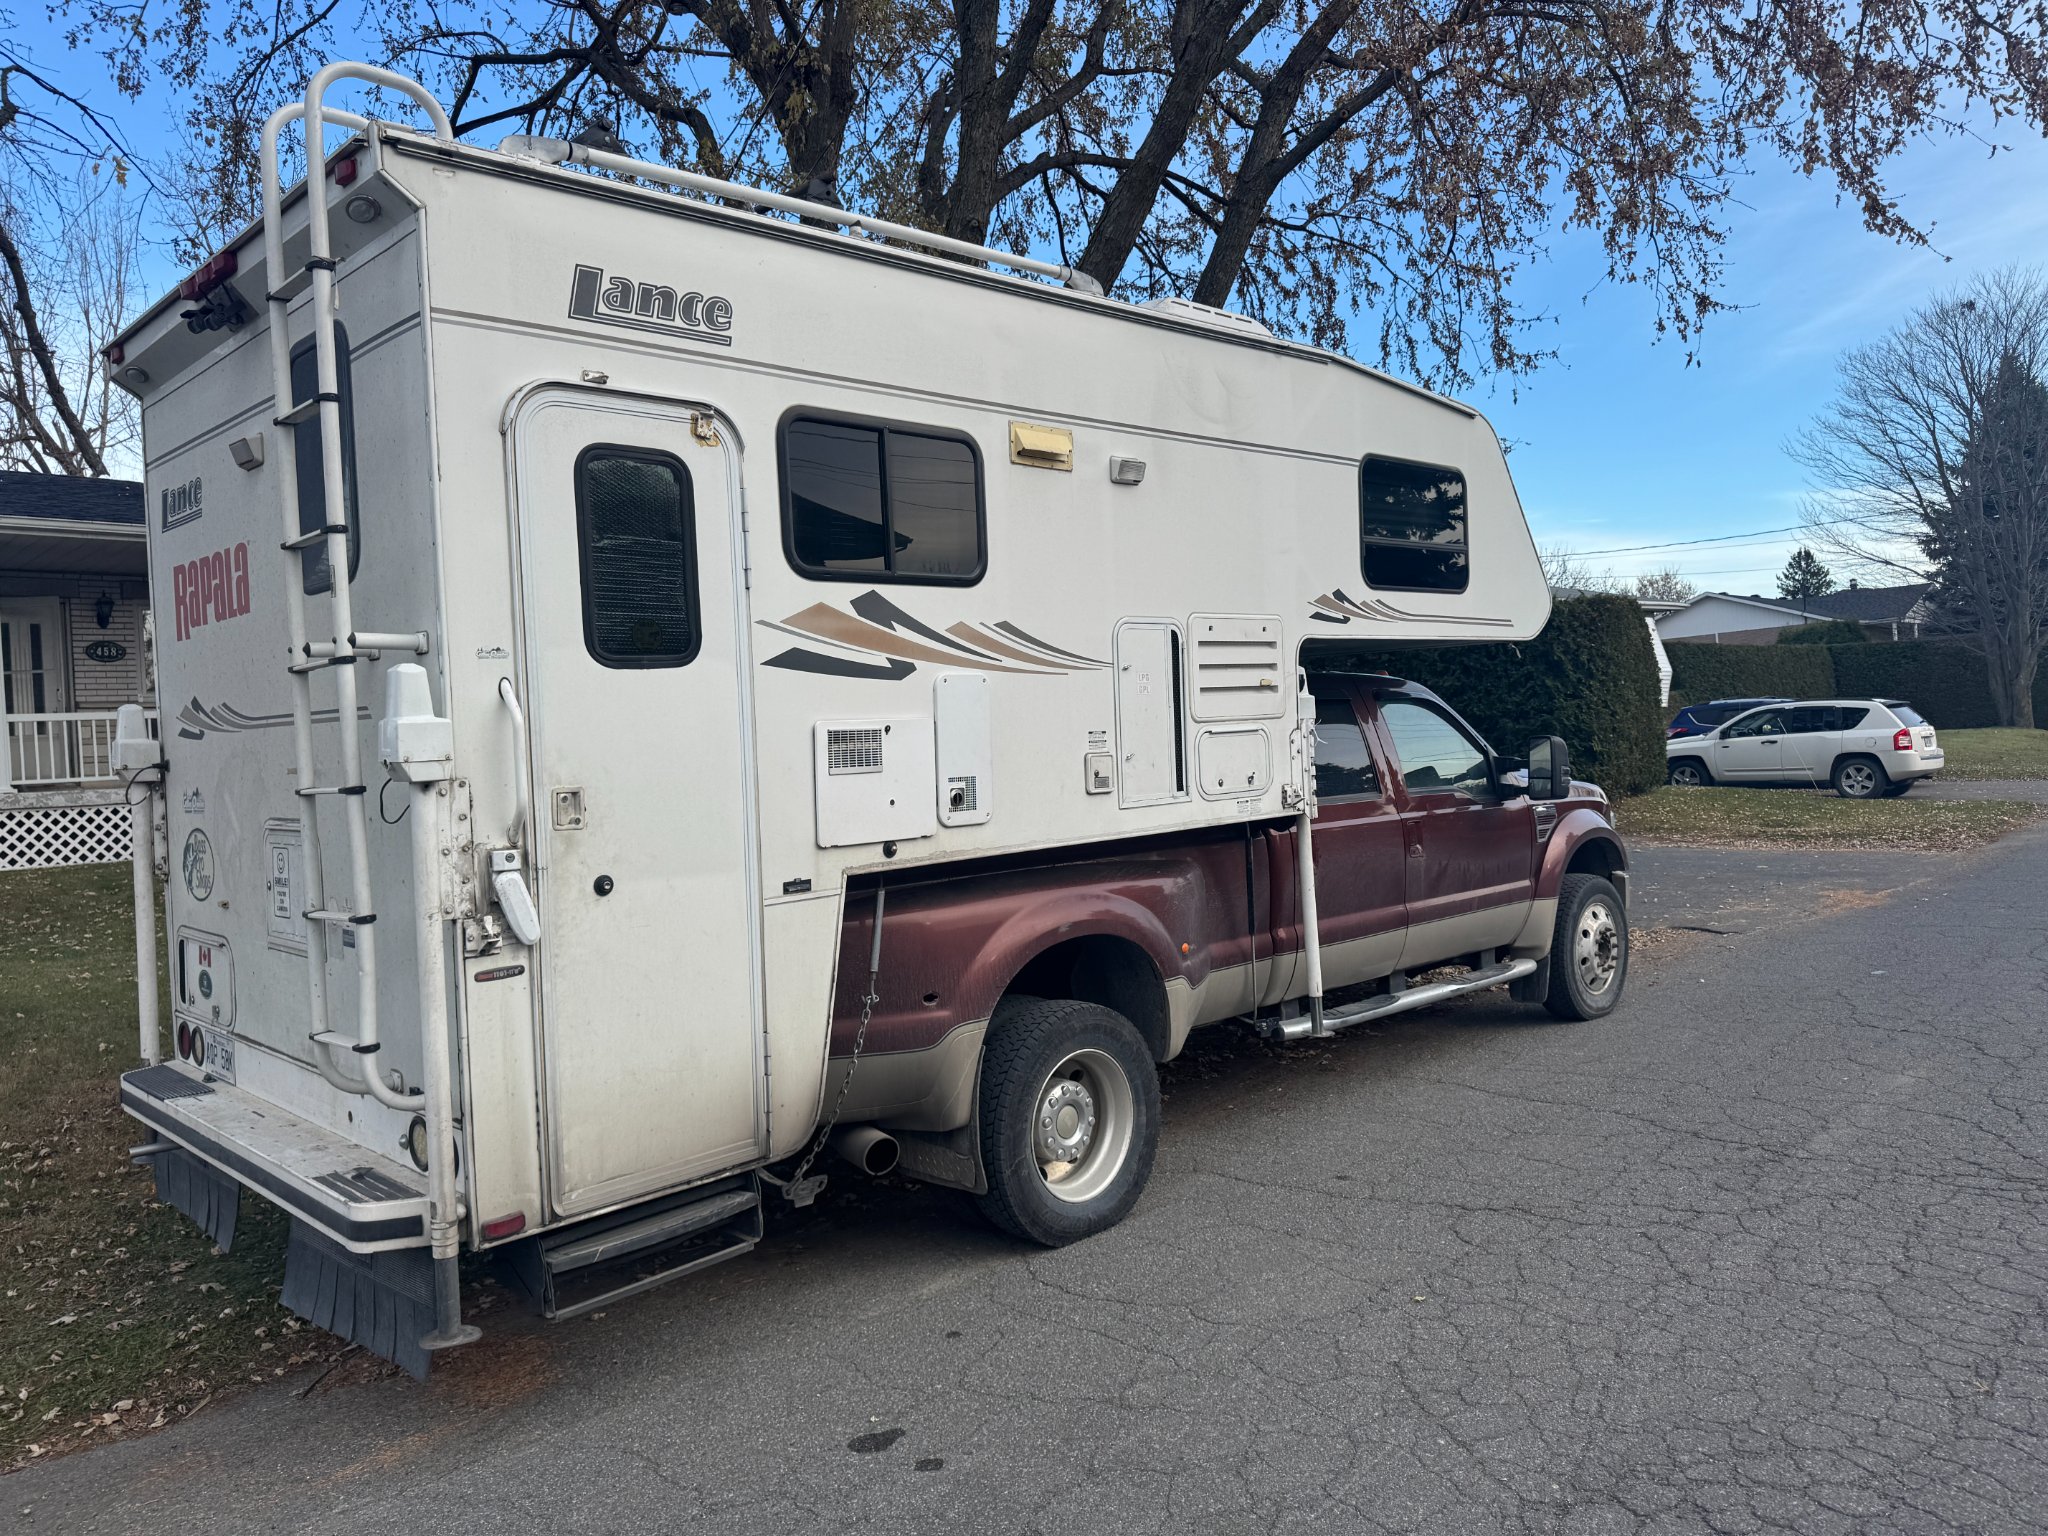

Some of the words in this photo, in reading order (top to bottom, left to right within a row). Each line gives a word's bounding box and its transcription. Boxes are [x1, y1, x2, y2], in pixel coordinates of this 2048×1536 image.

[568, 263, 733, 347] Lance
[162, 477, 202, 534] Lance
[96, 646, 117, 657] 458
[1138, 673, 1149, 681] LPG
[1138, 685, 1149, 694] GPL
